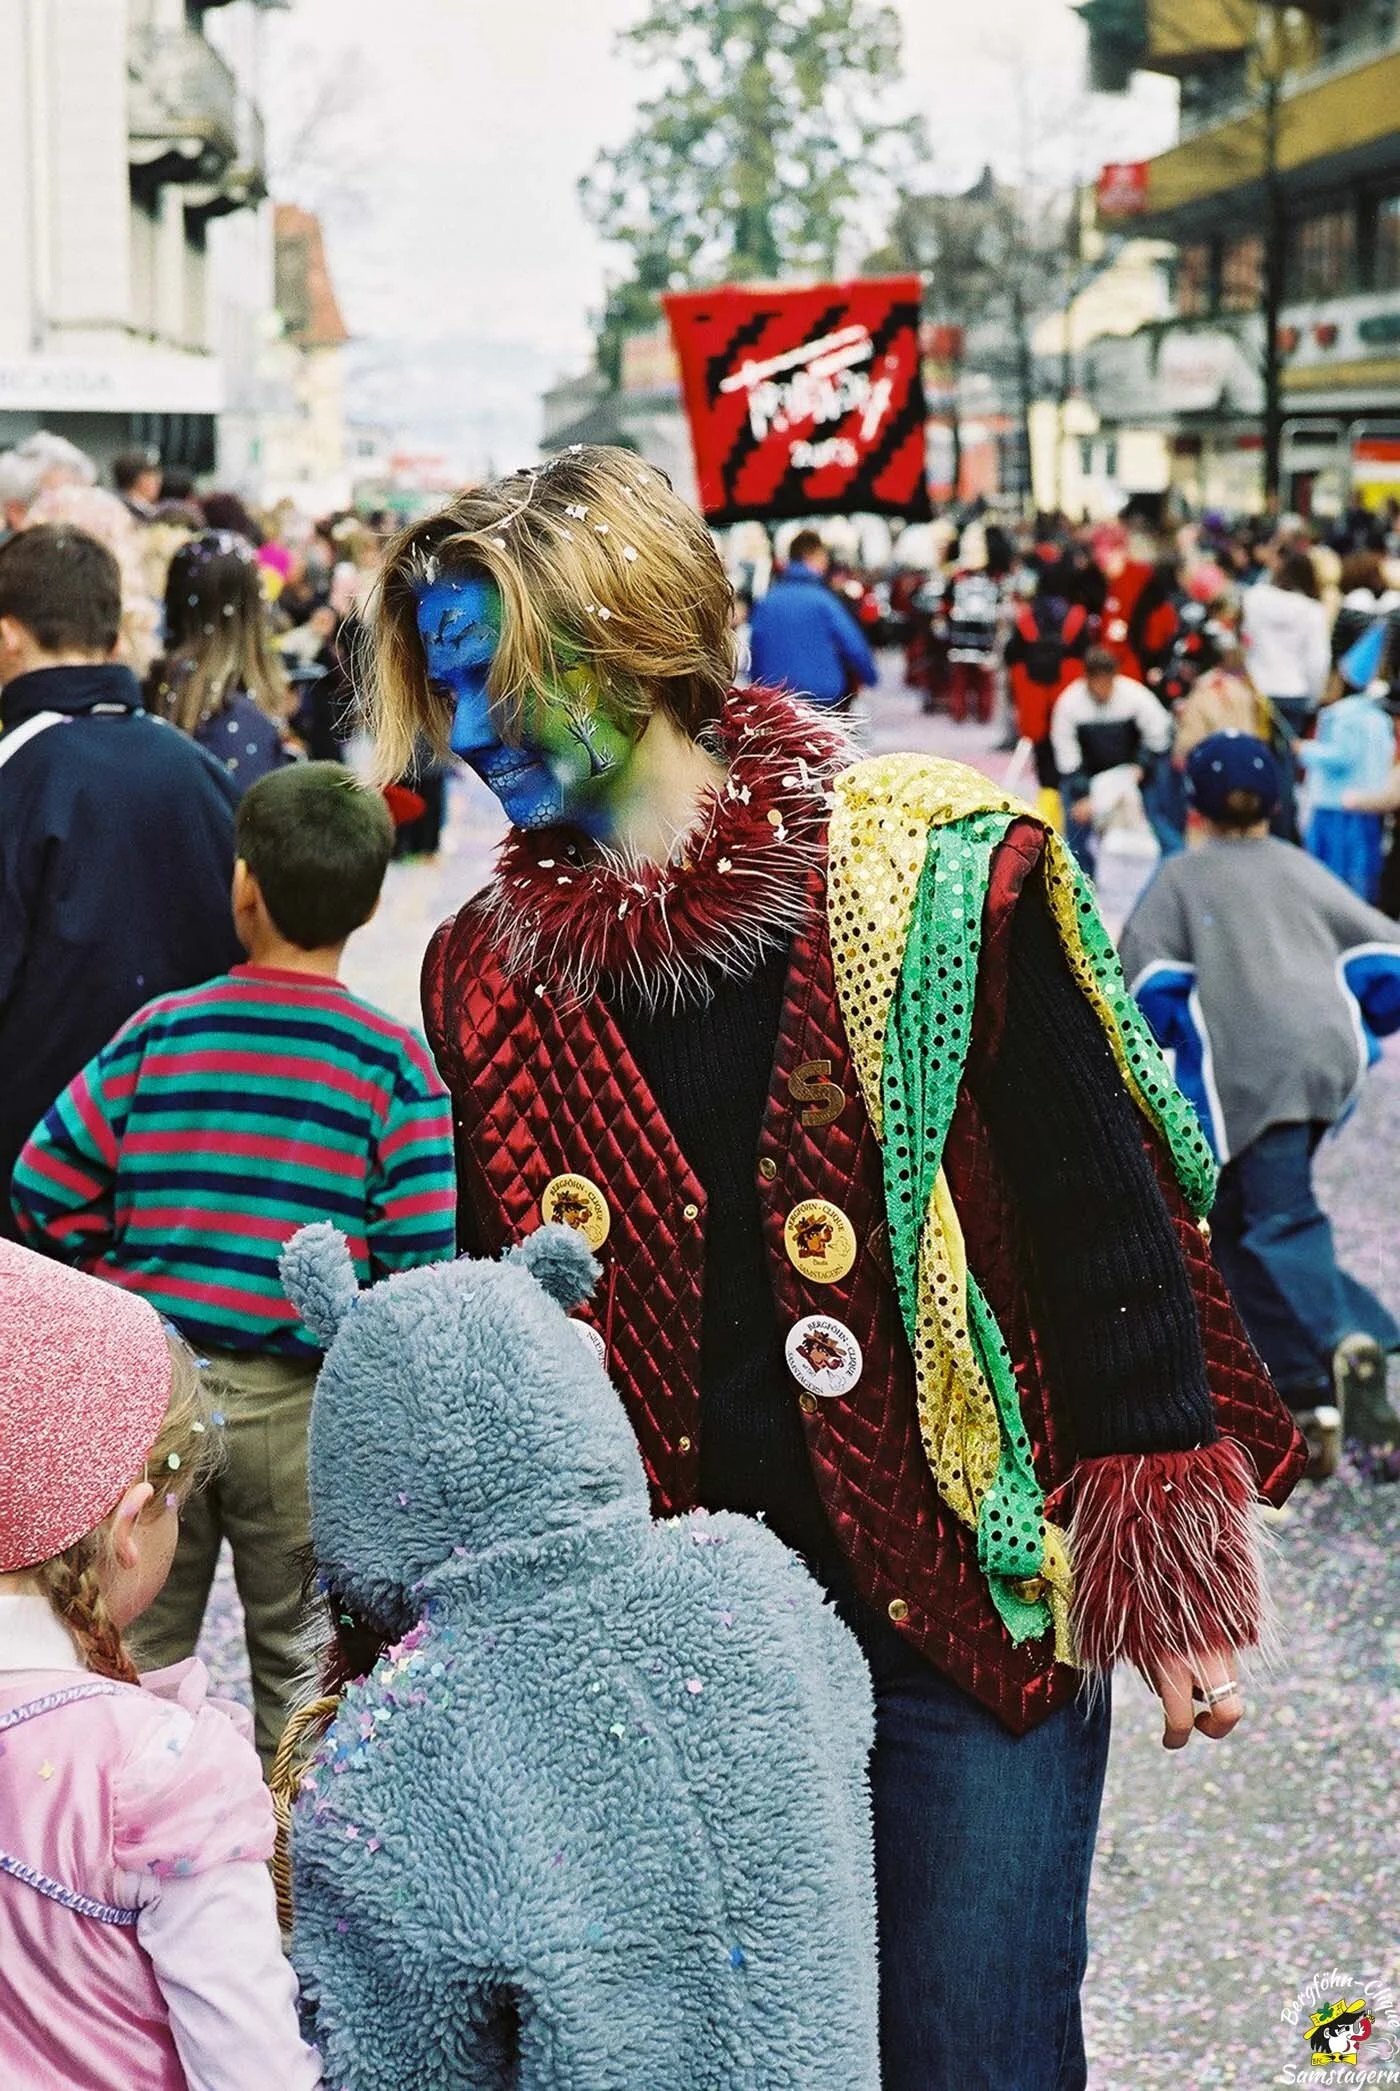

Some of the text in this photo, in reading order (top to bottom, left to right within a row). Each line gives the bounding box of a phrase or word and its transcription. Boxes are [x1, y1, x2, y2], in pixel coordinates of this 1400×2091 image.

[788, 1059, 846, 1126] S
[587, 1191, 603, 1222] CLIQUE
[822, 1205, 845, 1232] CLIQUE
[846, 1347, 857, 1377] CLIQUE
